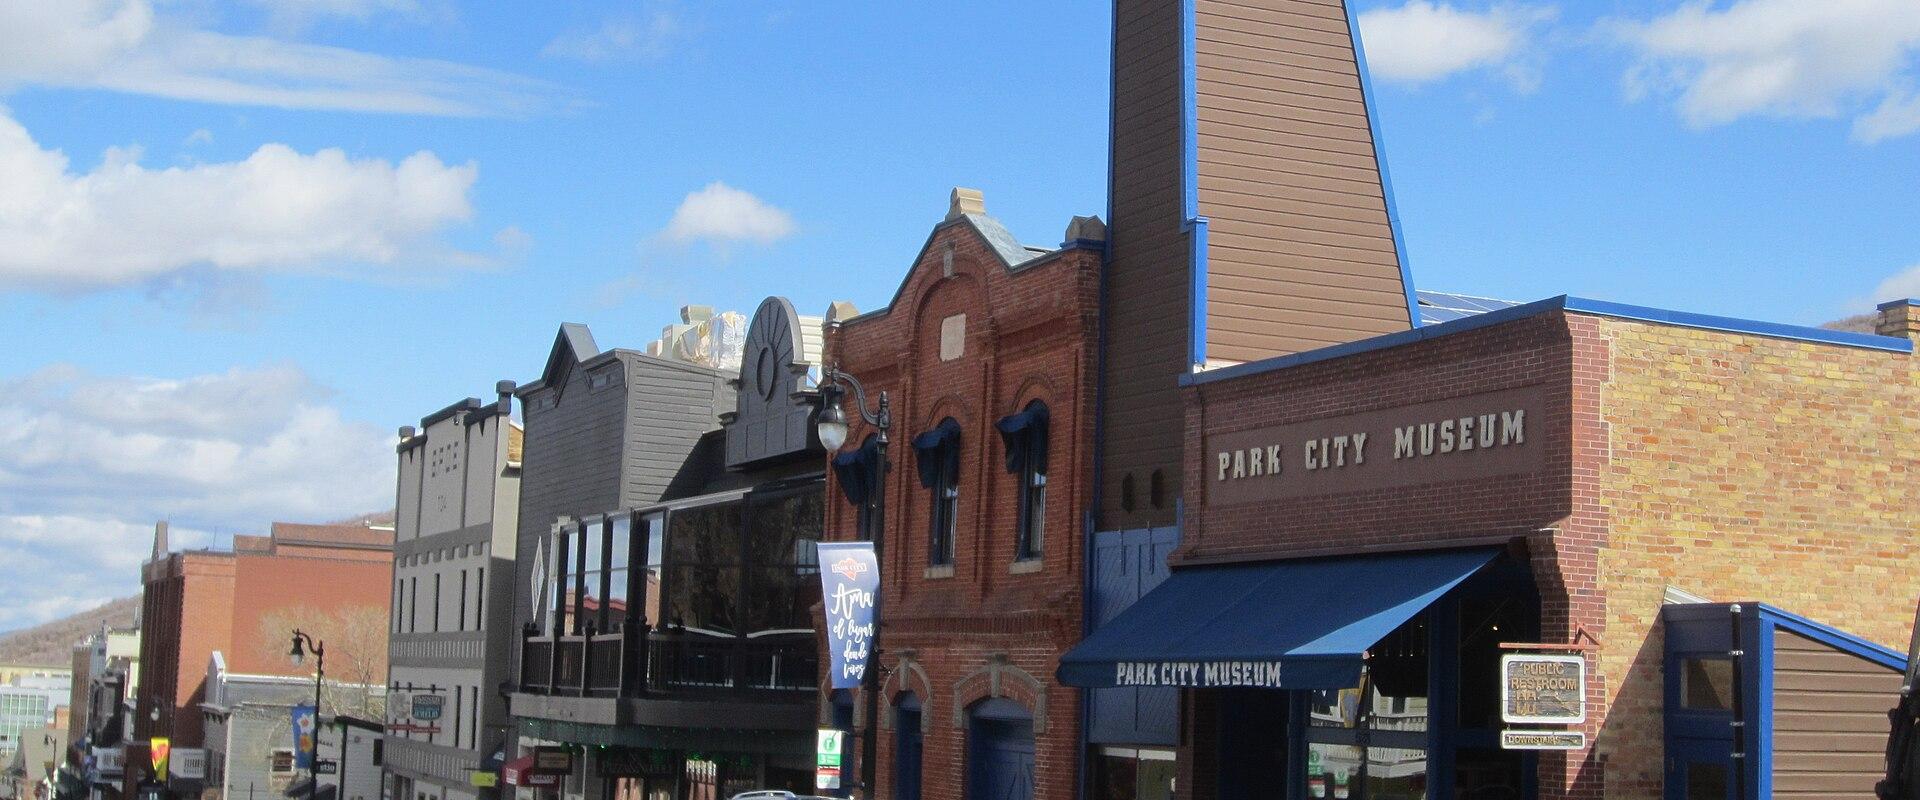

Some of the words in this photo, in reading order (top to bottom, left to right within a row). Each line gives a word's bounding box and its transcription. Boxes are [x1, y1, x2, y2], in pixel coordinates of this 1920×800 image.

[1218, 445, 1280, 481] PARK
[1305, 433, 1367, 470] CITY
[1393, 410, 1525, 460] MUSEUM
[831, 583, 874, 619] Ama
[833, 618, 845, 639] el
[848, 620, 875, 643] lugar
[843, 640, 867, 662] donde
[1116, 662, 1157, 686] PARK
[1161, 662, 1200, 686] CITY
[1204, 661, 1282, 688] MUSEUM
[1523, 662, 1564, 675] PUBLIC
[1511, 677, 1577, 691] RESTROOM
[1508, 735, 1560, 746] DOWNSTAIRS
